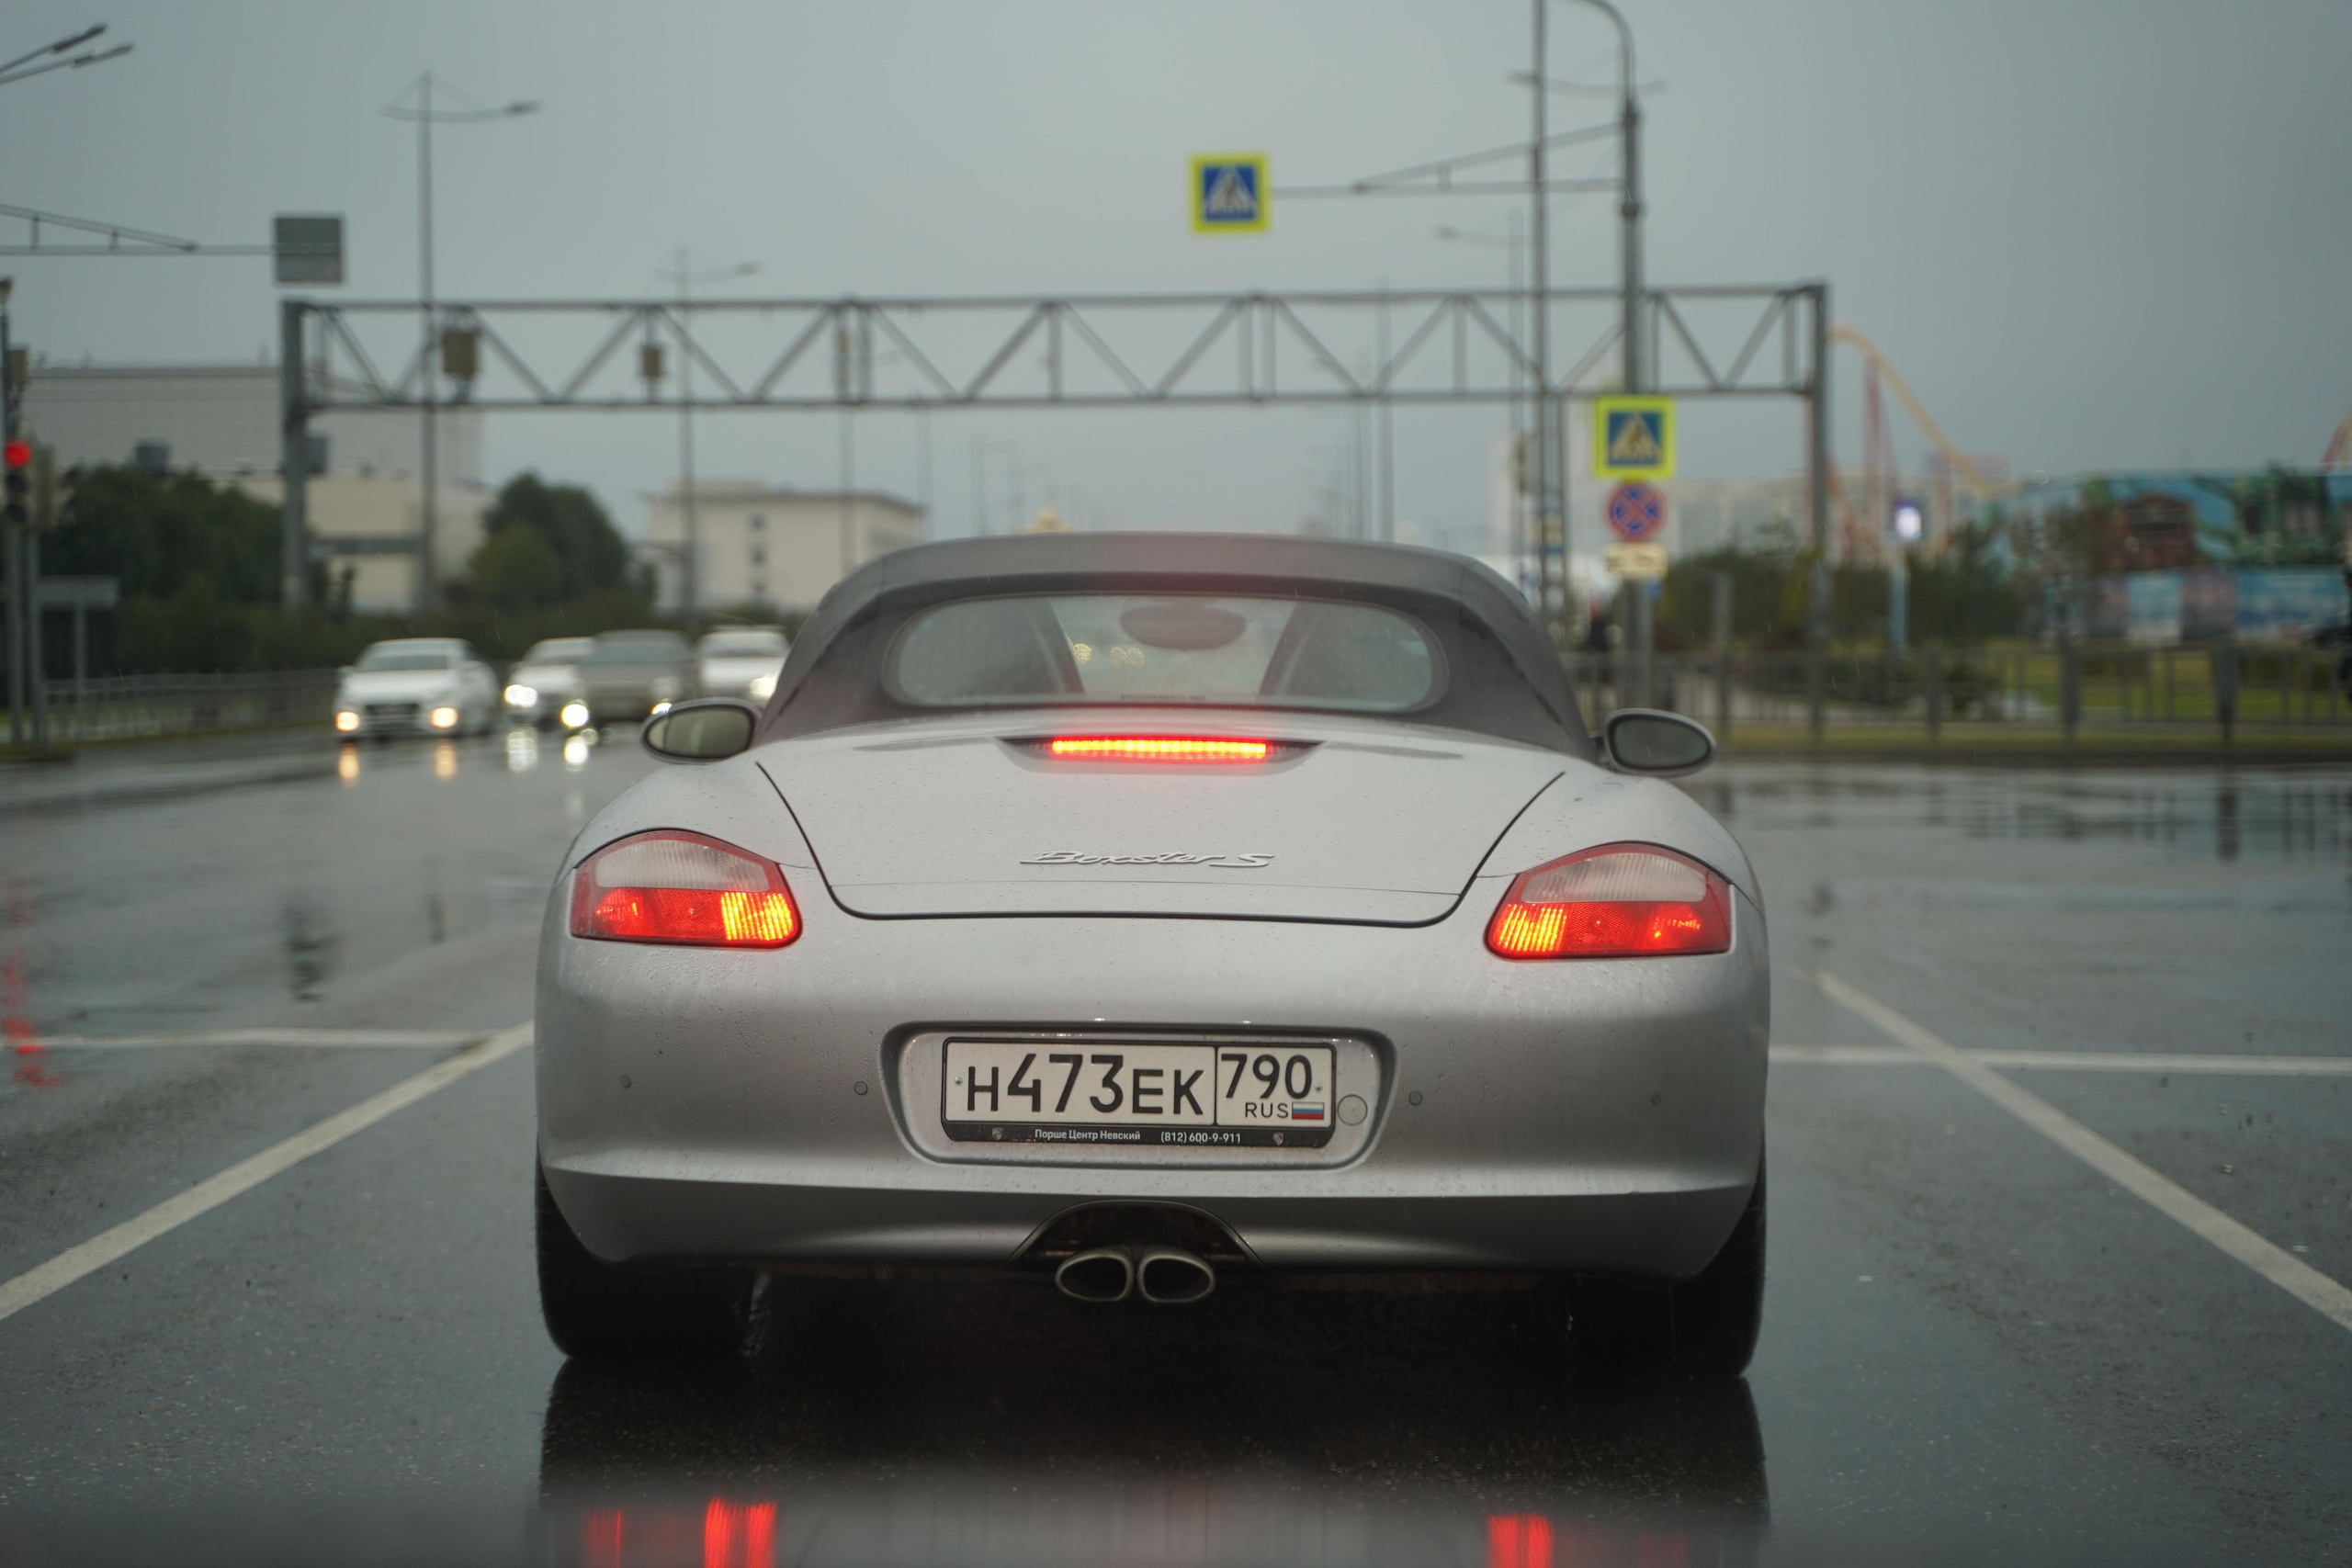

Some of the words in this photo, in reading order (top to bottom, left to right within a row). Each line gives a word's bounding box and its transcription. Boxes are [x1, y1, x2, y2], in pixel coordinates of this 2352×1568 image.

[1209, 853, 1275, 868] S
[1221, 1053, 1313, 1100] 790
[1244, 1102, 1290, 1120] RUS
[1035, 1129, 1068, 1141] Порше
[1069, 1129, 1098, 1141] Центр
[1100, 1130, 1141, 1141] Невский
[1160, 1131, 1187, 1143] (812)
[1189, 1132, 1241, 1144] 600-9-911
